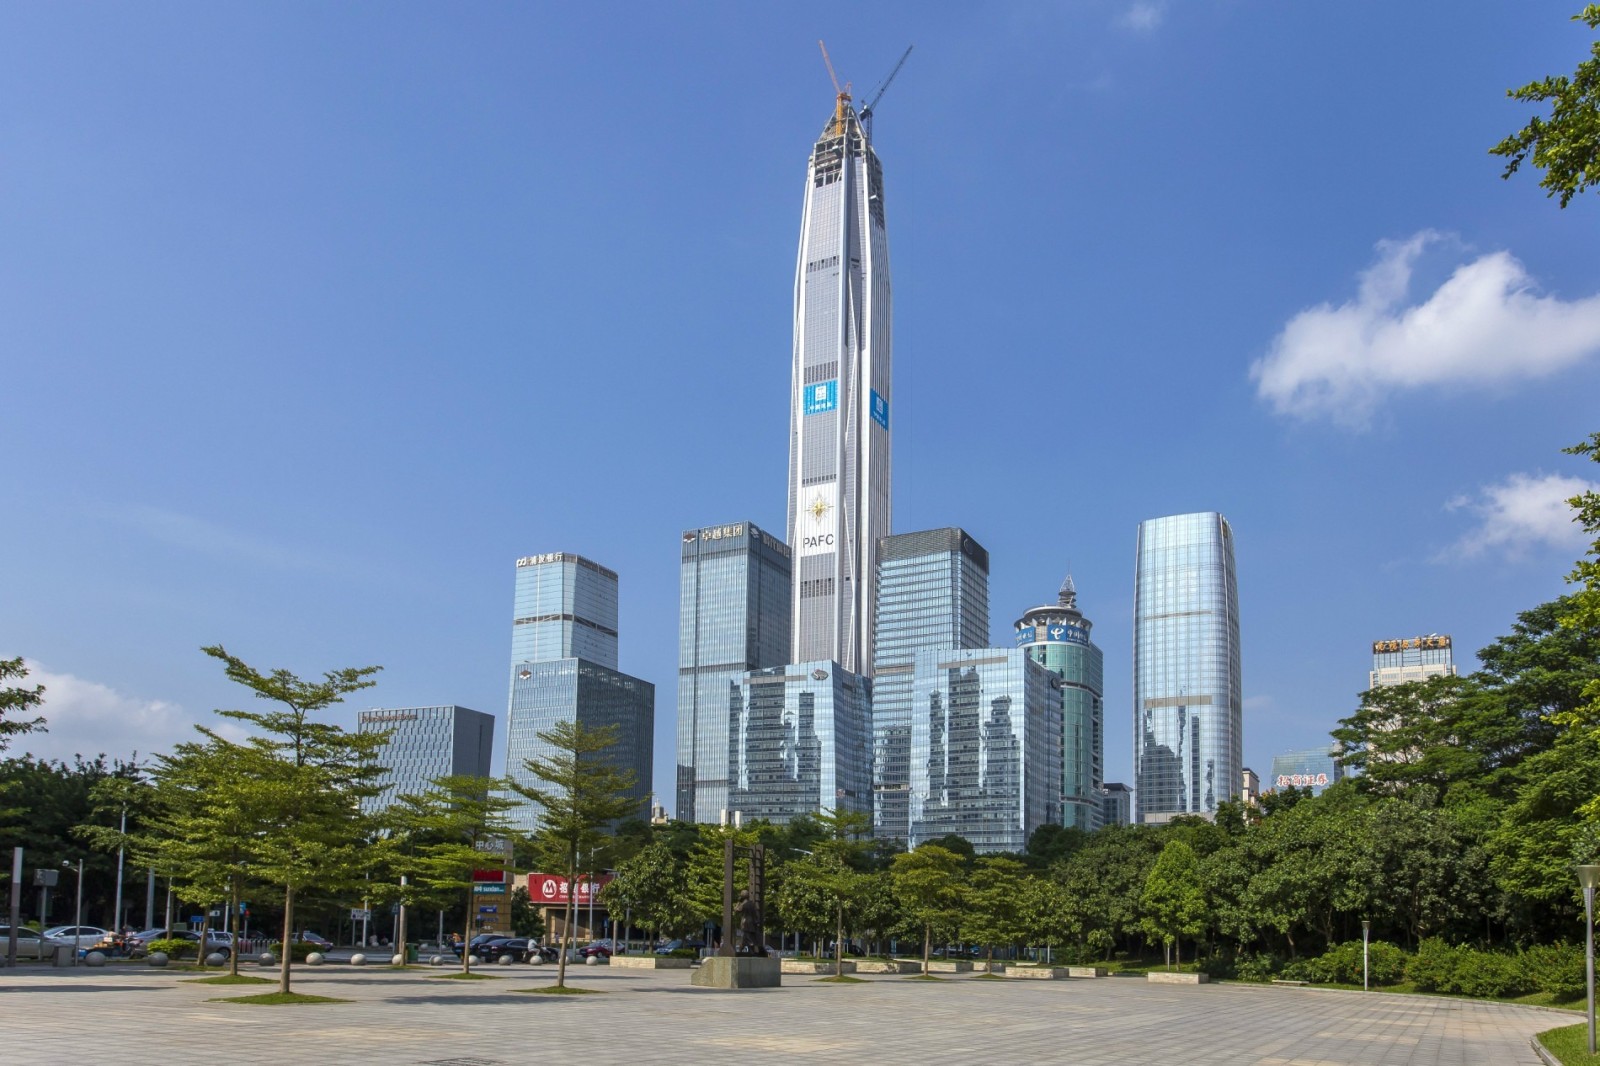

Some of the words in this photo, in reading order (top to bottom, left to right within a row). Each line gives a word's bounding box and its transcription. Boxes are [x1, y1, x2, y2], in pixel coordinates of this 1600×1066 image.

[702, 524, 743, 541] 卓越集团
[803, 534, 834, 548] PAFC
[1277, 773, 1328, 787] 招商证券
[559, 882, 600, 894] 招银行
